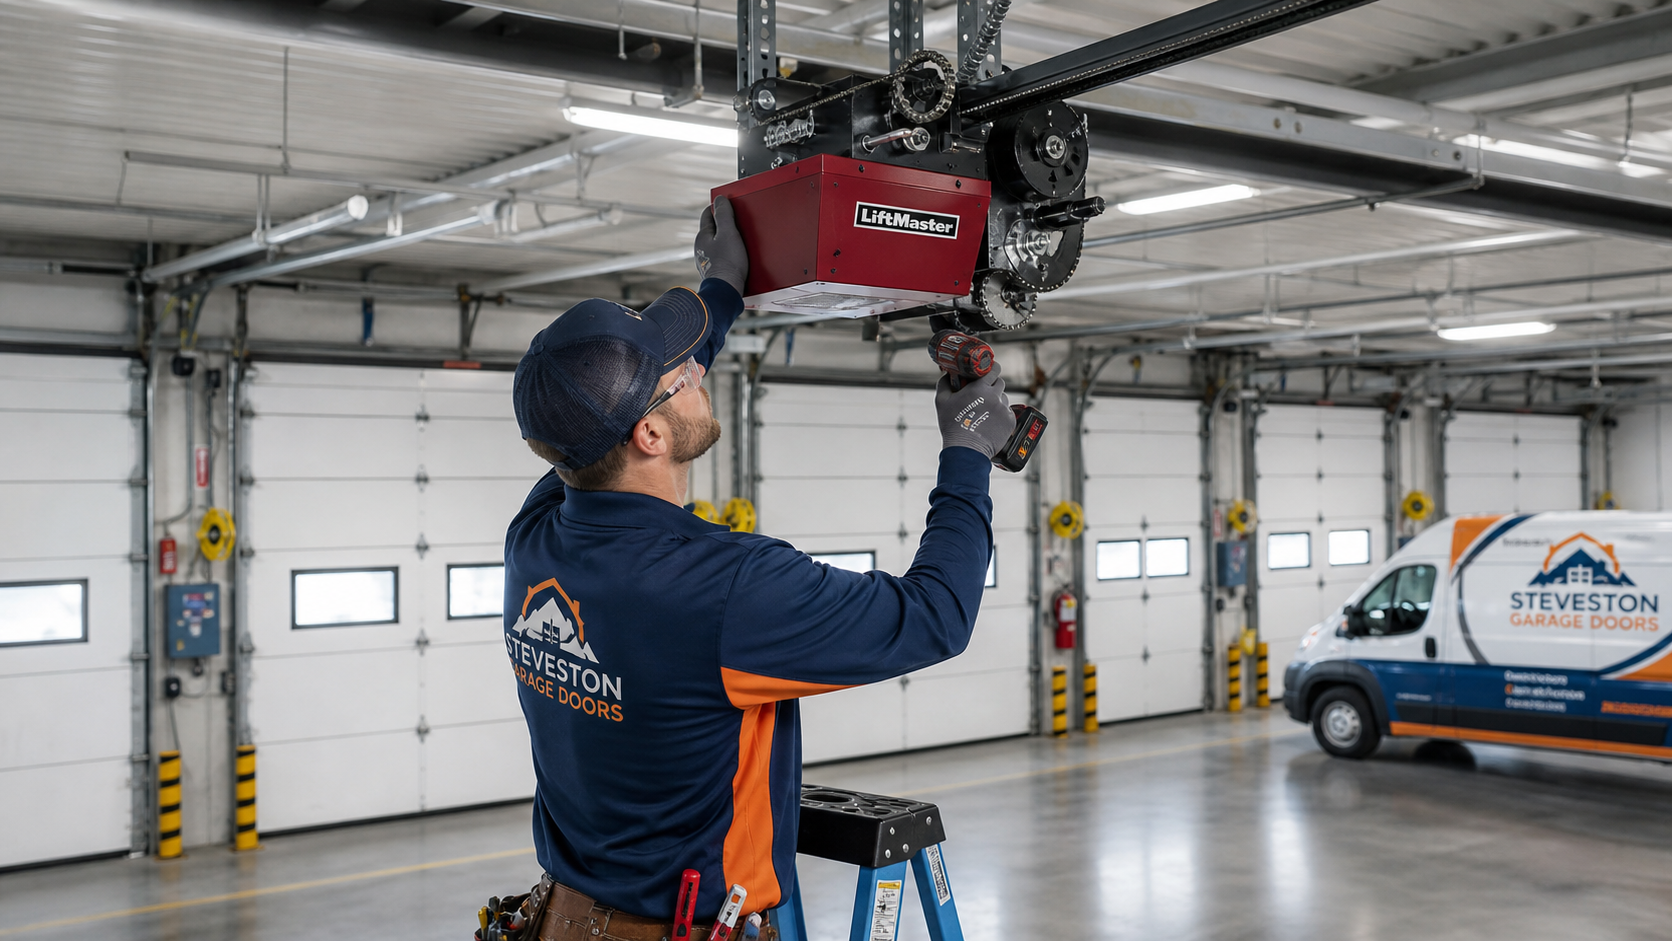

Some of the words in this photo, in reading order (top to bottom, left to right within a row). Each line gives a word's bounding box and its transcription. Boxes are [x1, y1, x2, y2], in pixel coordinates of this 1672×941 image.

[861, 208, 953, 233] LiftMaster
[1511, 592, 1659, 613] STEVESTON
[1510, 612, 1584, 629] GARAGE
[1590, 615, 1659, 632] DOORS
[505, 633, 622, 701] STEVESTON
[558, 686, 624, 722] DOORS
